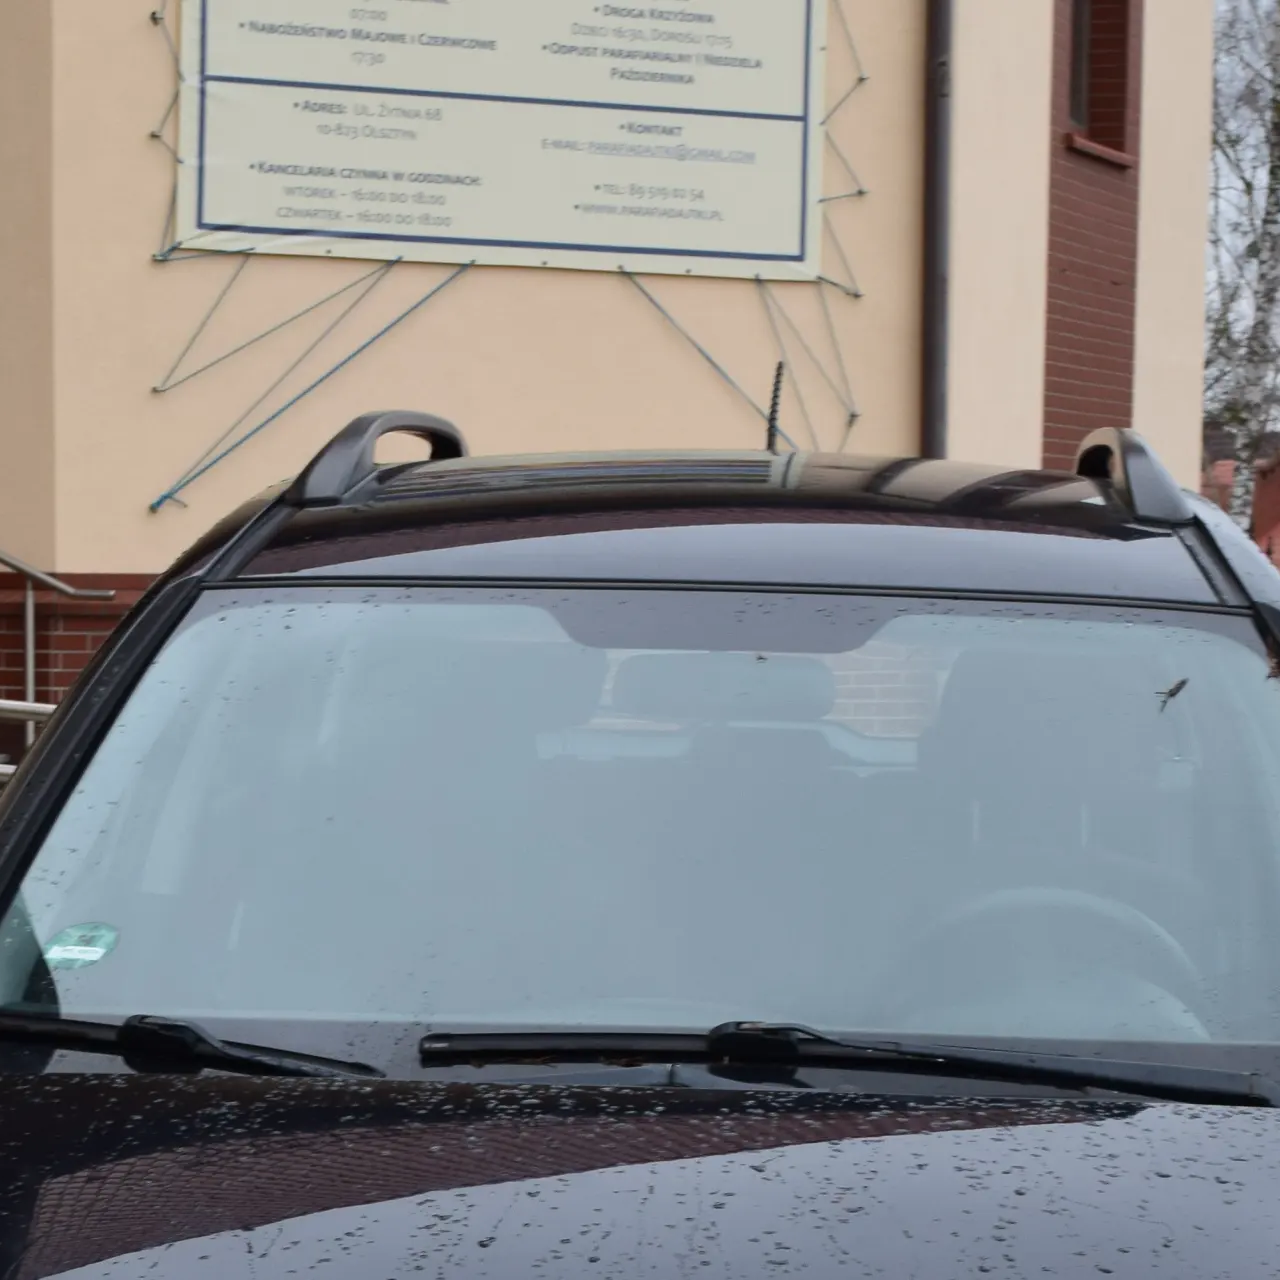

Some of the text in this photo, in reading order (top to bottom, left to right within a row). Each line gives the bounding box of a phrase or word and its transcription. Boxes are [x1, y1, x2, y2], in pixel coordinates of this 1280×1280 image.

[603, 4, 645, 19] DROGA
[350, 28, 408, 44] MAJOWE
[627, 122, 683, 137] KONTAKT
[258, 161, 337, 179] KANCELARIA
